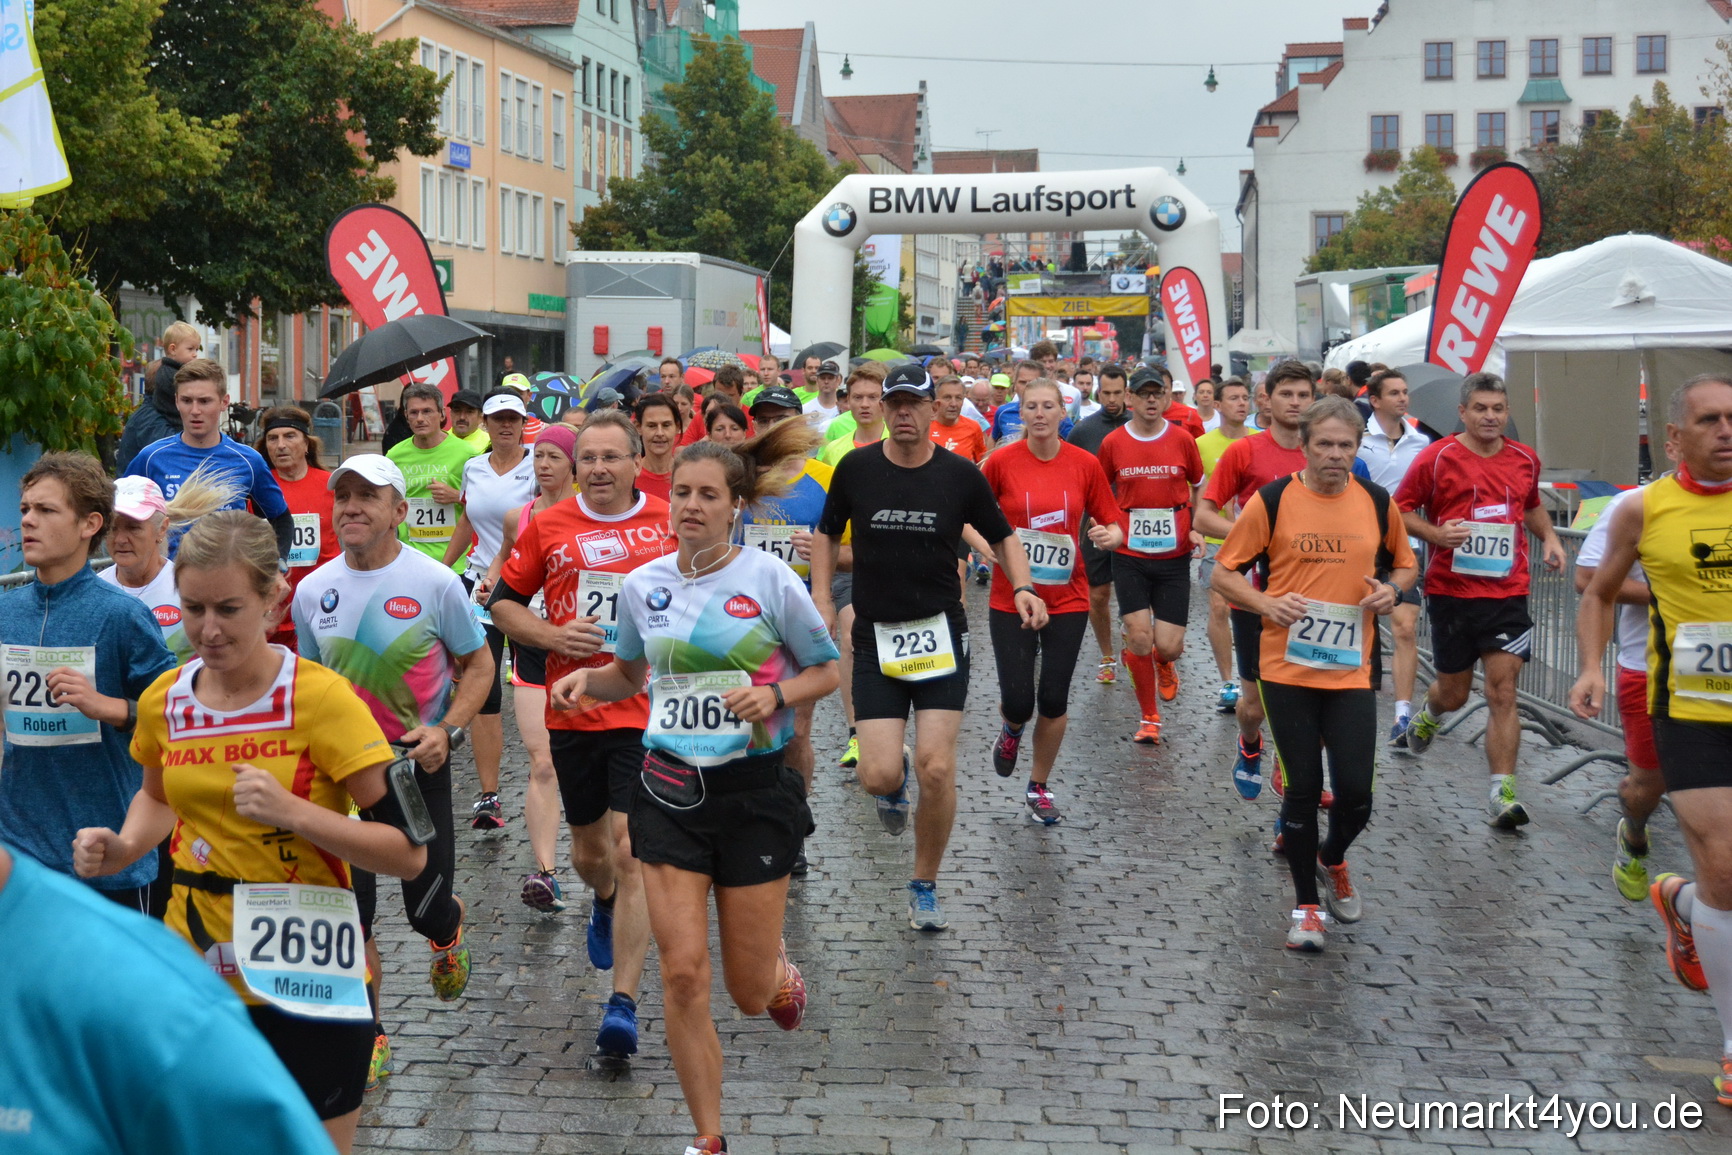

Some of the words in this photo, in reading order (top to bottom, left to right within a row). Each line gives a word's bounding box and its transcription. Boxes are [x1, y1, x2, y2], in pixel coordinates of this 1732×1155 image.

[869, 186, 960, 214] BMW
[971, 184, 1136, 216] Laufsport
[1436, 193, 1526, 376] REWE
[1062, 300, 1095, 313] ZIEL
[1167, 278, 1206, 364] REWE
[403, 464, 449, 474] NOVINA
[1120, 465, 1169, 477] NEUMARKT
[416, 508, 446, 526] 214
[871, 509, 937, 525] ARZT
[419, 529, 444, 537] Thomas
[1133, 519, 1171, 536] 2645
[579, 530, 617, 542] raumbox
[1141, 540, 1163, 548] Jürgen
[1300, 539, 1347, 554] OEXL
[1461, 535, 1510, 557] 3076
[389, 601, 417, 614] Hervis
[319, 616, 339, 625] PARTL
[648, 614, 670, 623] PARTL
[1298, 615, 1355, 647] 2771
[892, 629, 938, 658] 223
[35, 650, 85, 663] BOCK
[1311, 648, 1338, 662] Franz
[901, 660, 936, 673] Helmut
[695, 674, 741, 687] BOCK
[659, 695, 744, 730] 3064
[23, 716, 68, 732] Robert
[164, 747, 215, 767] MAX
[224, 738, 296, 763] BÖGL
[299, 889, 354, 909] BOCK
[249, 914, 356, 970] 2690
[274, 976, 333, 1000] Marina
